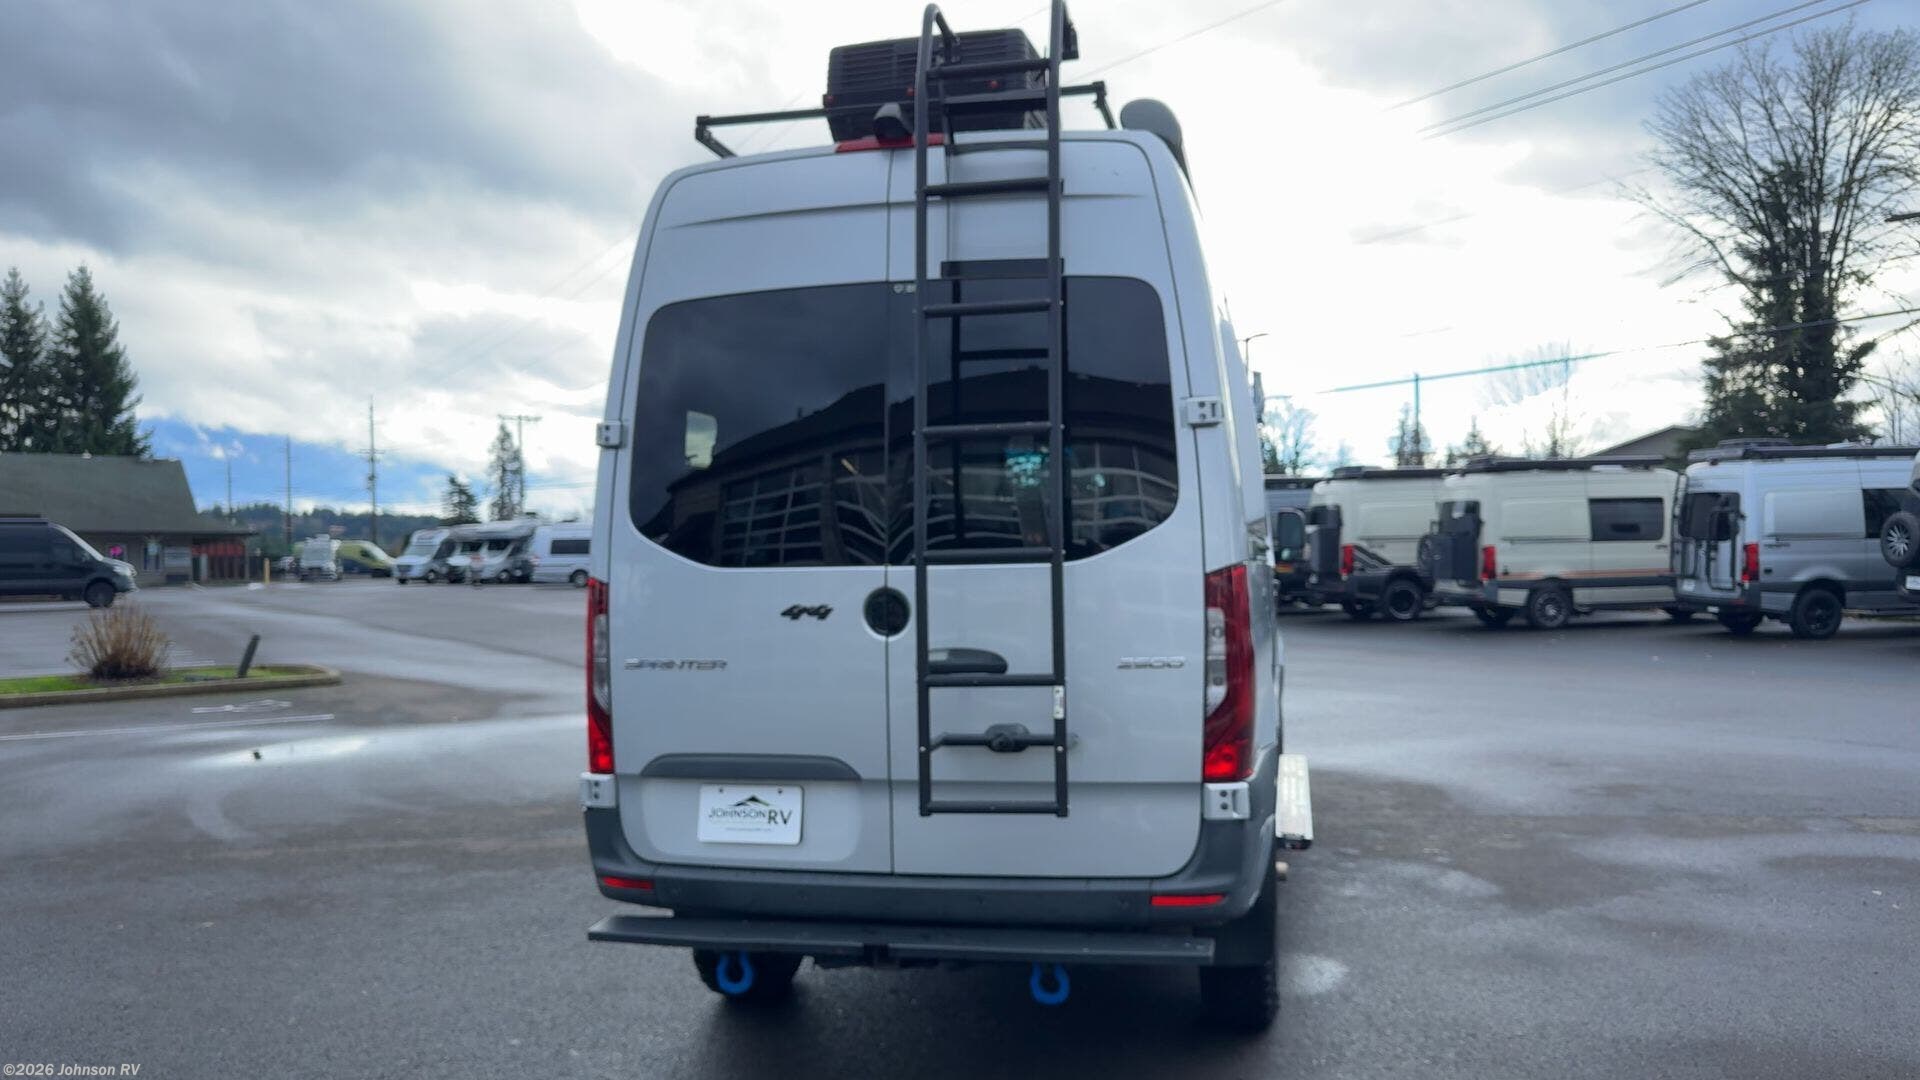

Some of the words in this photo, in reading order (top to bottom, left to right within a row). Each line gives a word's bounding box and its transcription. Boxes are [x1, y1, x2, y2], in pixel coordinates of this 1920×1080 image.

[624, 657, 728, 671] SPRINTER
[708, 807, 766, 819] JOHNSON
[767, 809, 793, 825] RV
